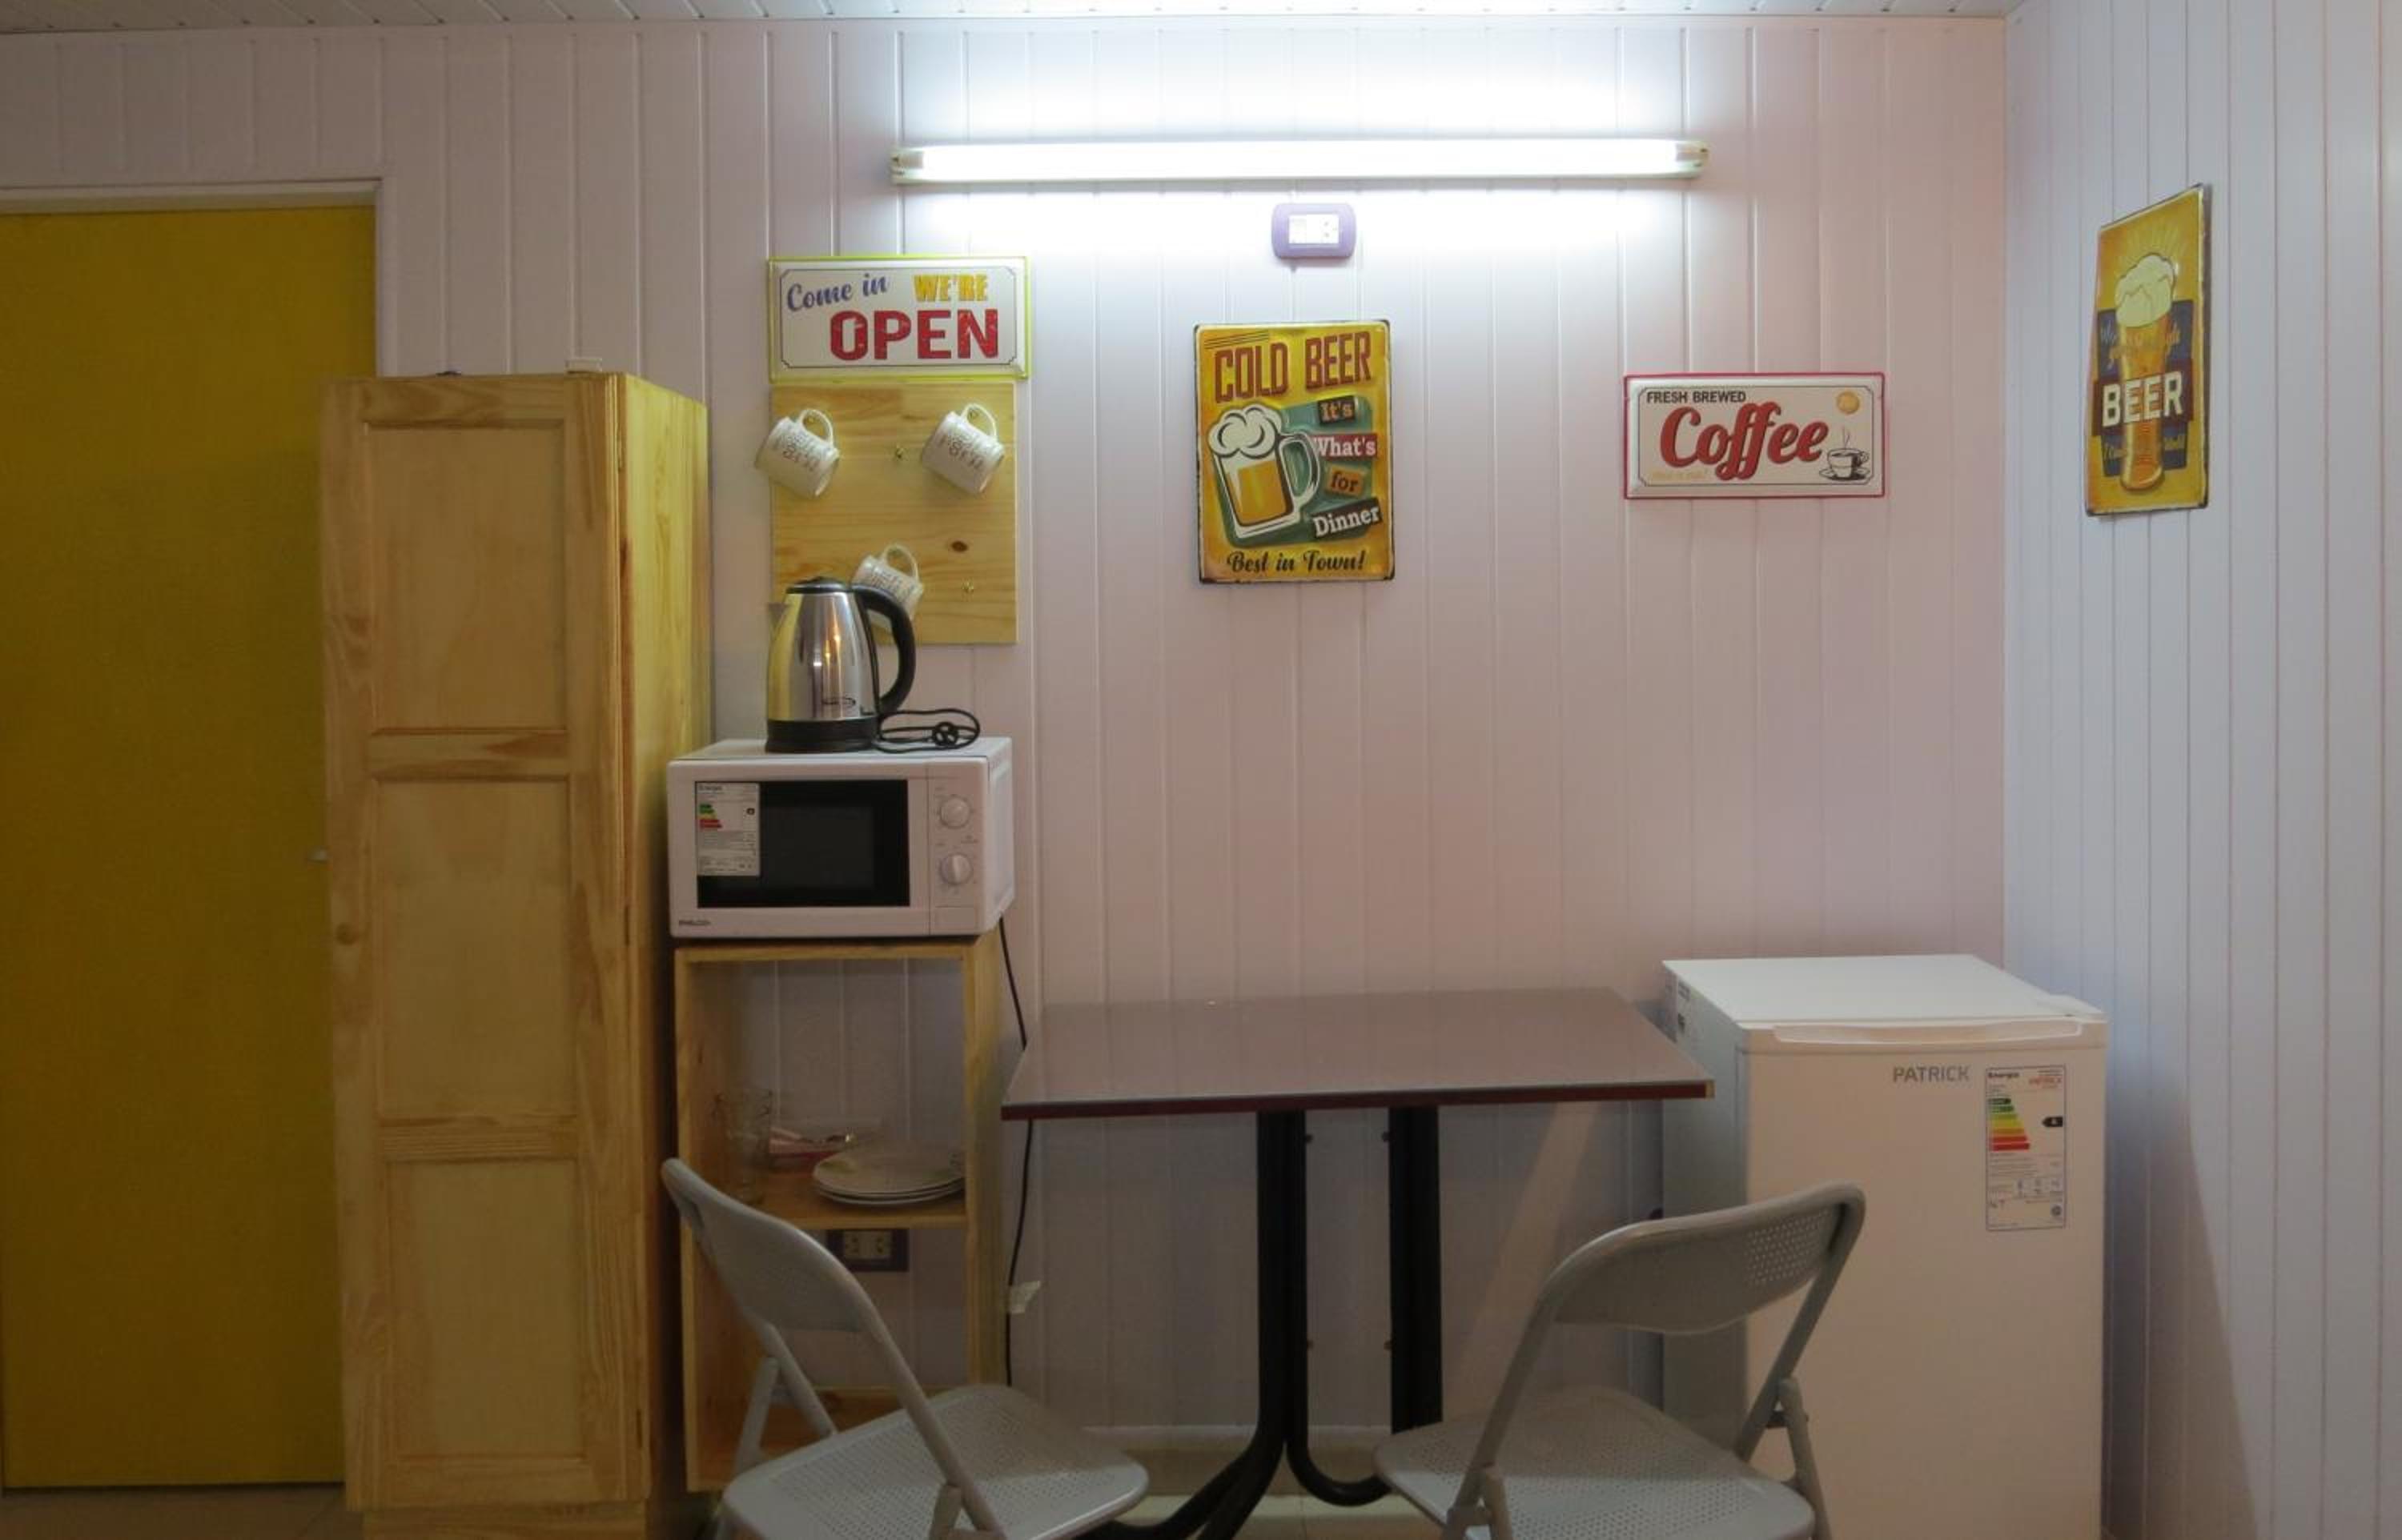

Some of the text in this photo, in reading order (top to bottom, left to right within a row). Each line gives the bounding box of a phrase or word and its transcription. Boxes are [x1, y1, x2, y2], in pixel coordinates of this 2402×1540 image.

[787, 273, 889, 312] Come in
[914, 274, 988, 303] WE'RE
[829, 308, 998, 361] OPEN
[1215, 331, 1372, 403] COLD BEER
[1646, 391, 1746, 403] FRESH BREWED
[2102, 371, 2184, 428] BEER
[1319, 401, 1353, 423] It's
[1312, 437, 1376, 457] What's
[1660, 401, 1829, 481] Coffee
[1331, 471, 1359, 491] for
[1313, 506, 1381, 536] Dinner
[1227, 550, 1367, 573] Best in Town!
[1892, 1065, 1971, 1083] PATRICK
